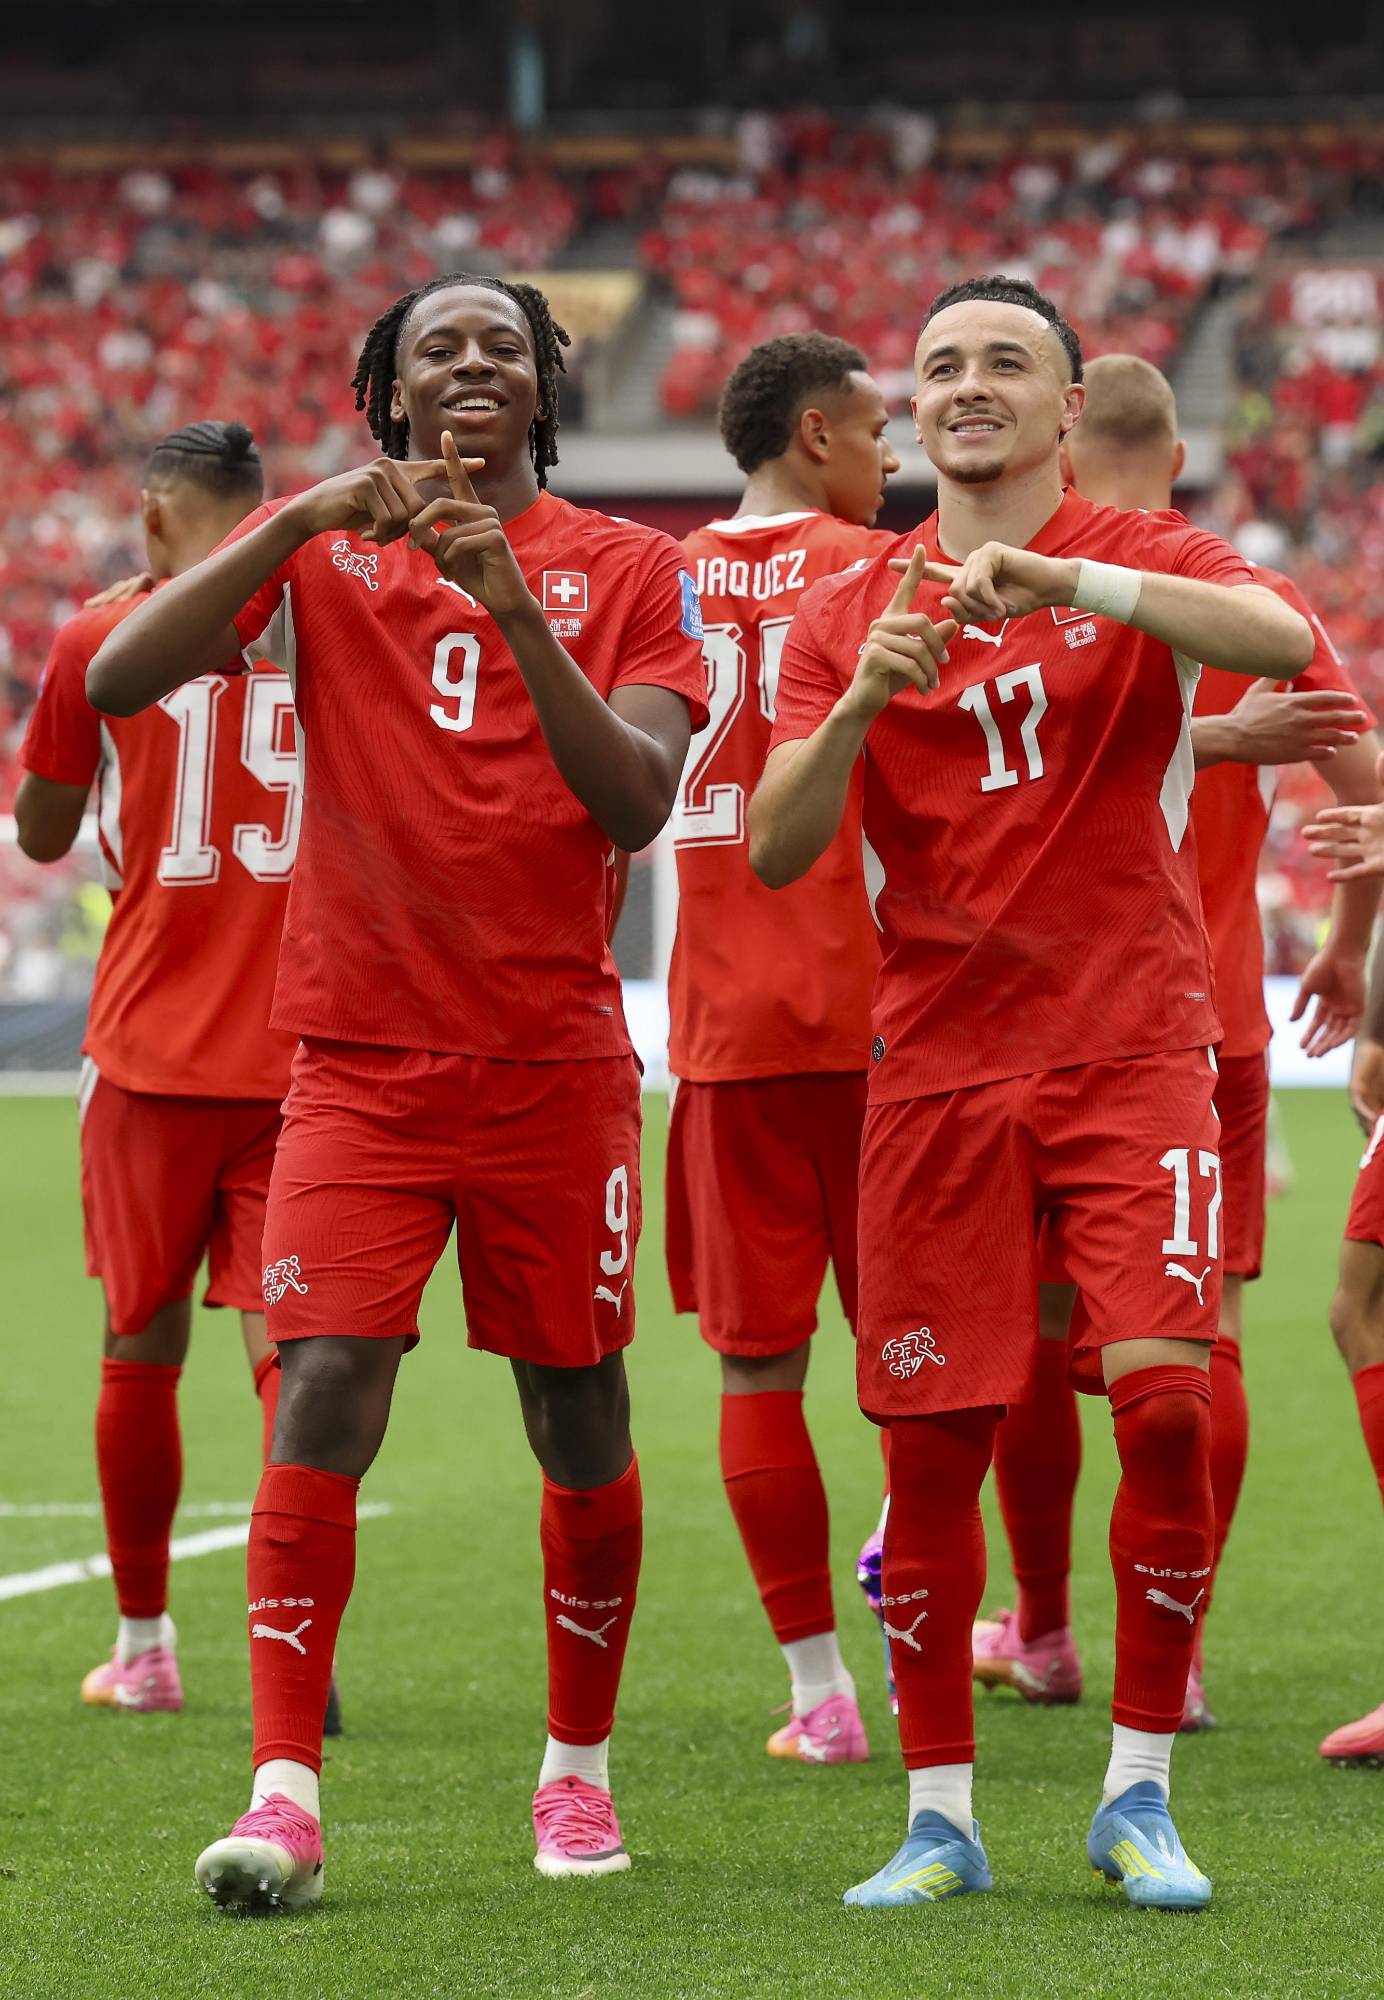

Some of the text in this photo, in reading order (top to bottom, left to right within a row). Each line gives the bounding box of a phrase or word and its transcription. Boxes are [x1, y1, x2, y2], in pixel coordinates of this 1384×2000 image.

[694, 548, 807, 601] JAQUEZ
[430, 632, 480, 733] 9
[673, 615, 795, 850] 2
[957, 662, 1049, 793] 17
[599, 1165, 628, 1276] 9
[1158, 1148, 1222, 1260] 17
[247, 1597, 315, 1614] suisse
[550, 1590, 622, 1609] suisse
[1134, 1563, 1210, 1579] suisse
